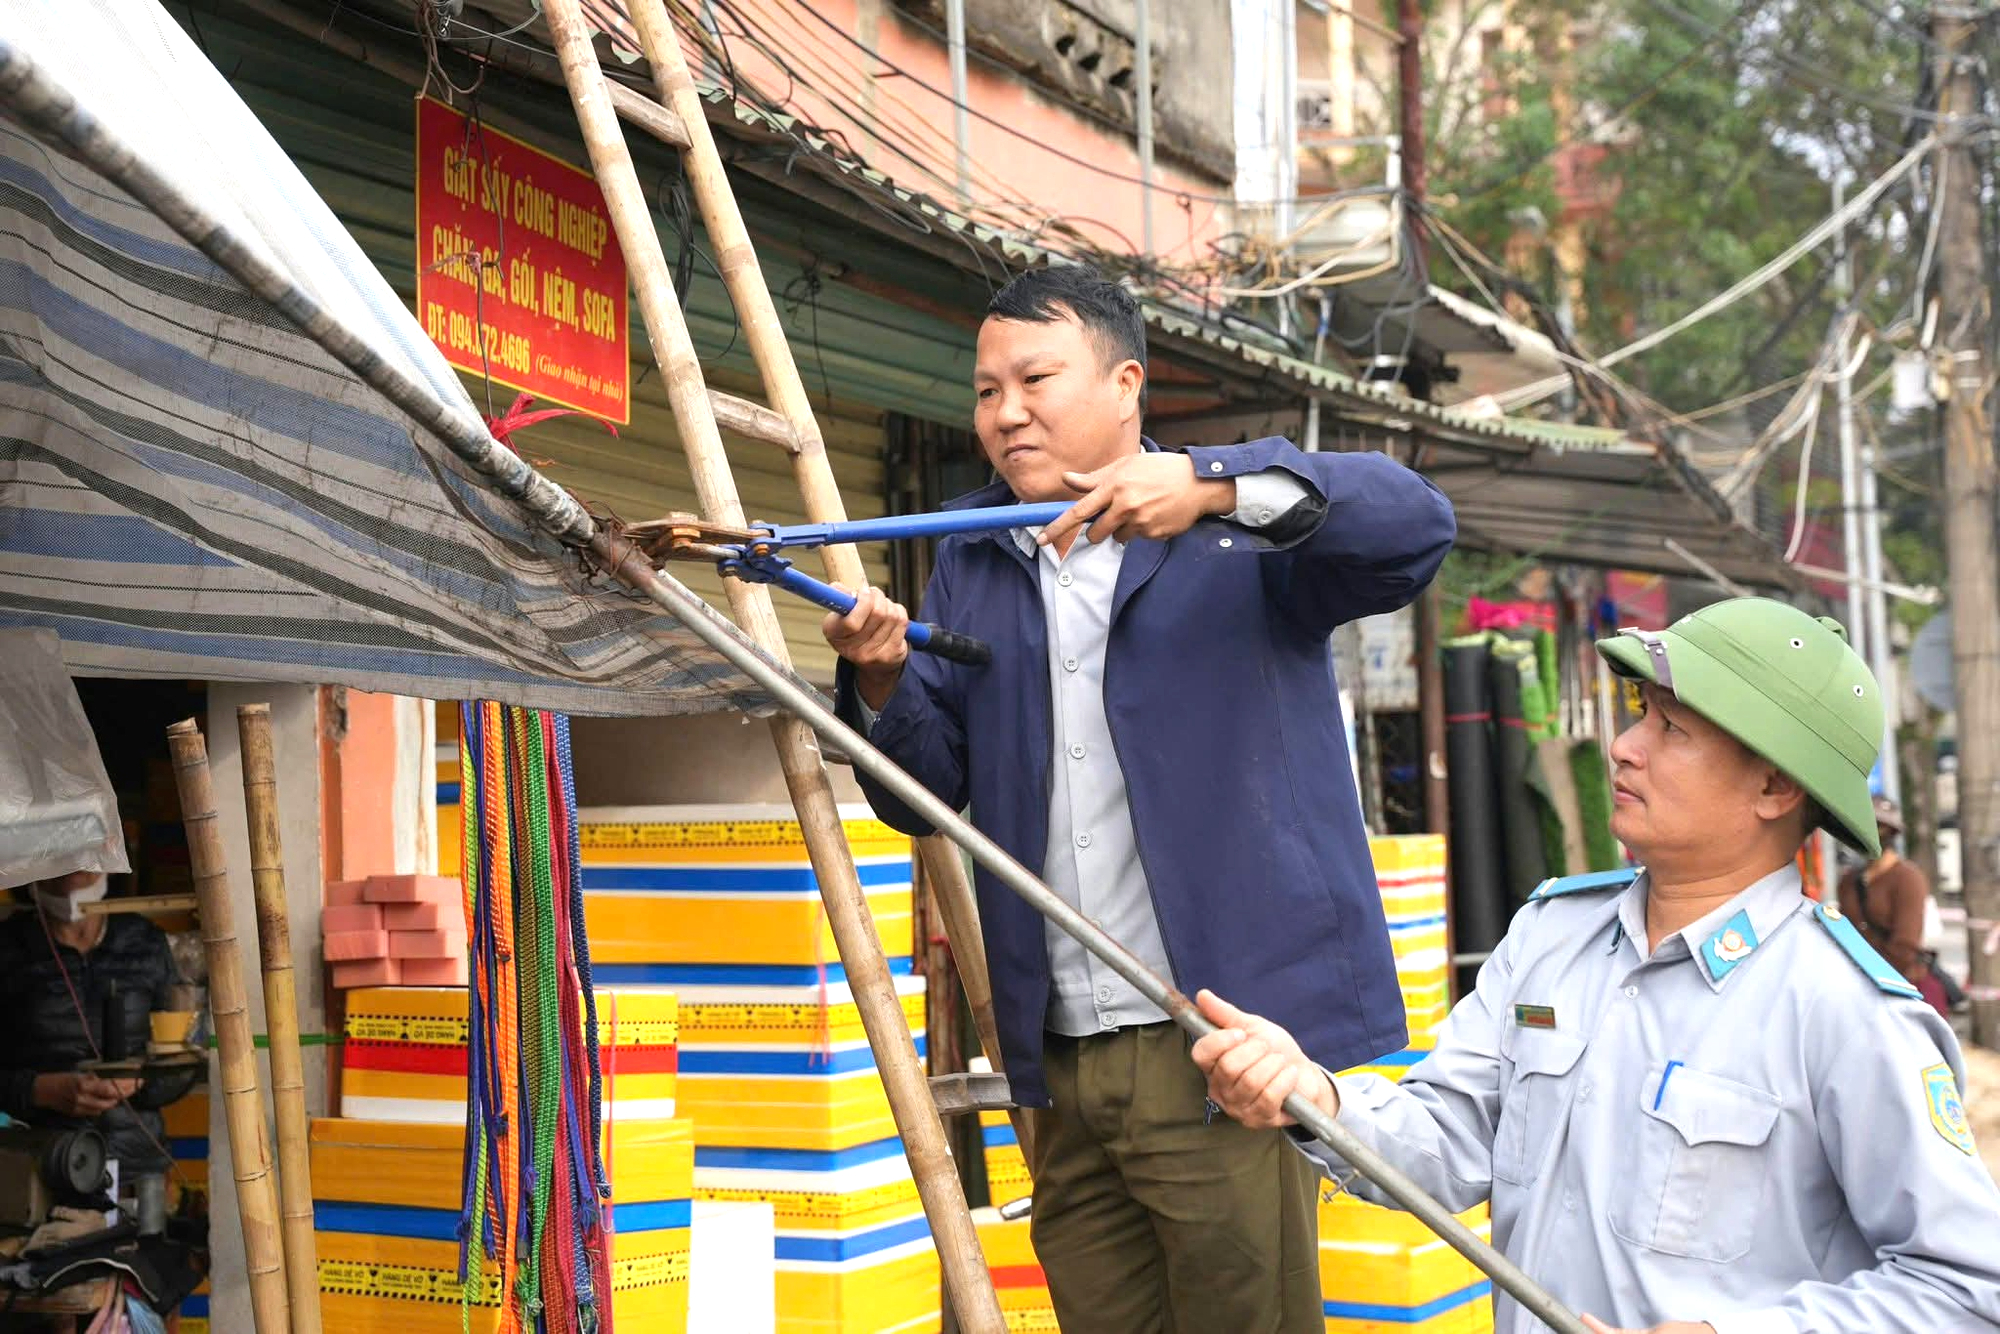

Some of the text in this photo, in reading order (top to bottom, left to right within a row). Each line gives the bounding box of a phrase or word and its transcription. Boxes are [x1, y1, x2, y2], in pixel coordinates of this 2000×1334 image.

[481, 155, 510, 220] SẤY
[514, 174, 555, 238] CÔNG
[558, 199, 607, 267] NGHIỆP
[483, 245, 507, 306] GA,
[510, 246, 540, 317] GỐI,
[543, 265, 579, 334] NỆM,
[583, 287, 616, 342] SOFA
[427, 301, 447, 345] ĐT:
[535, 352, 562, 379] (Giao
[562, 364, 588, 390] nhận
[588, 374, 602, 395] tại
[602, 379, 624, 403] nhà)
